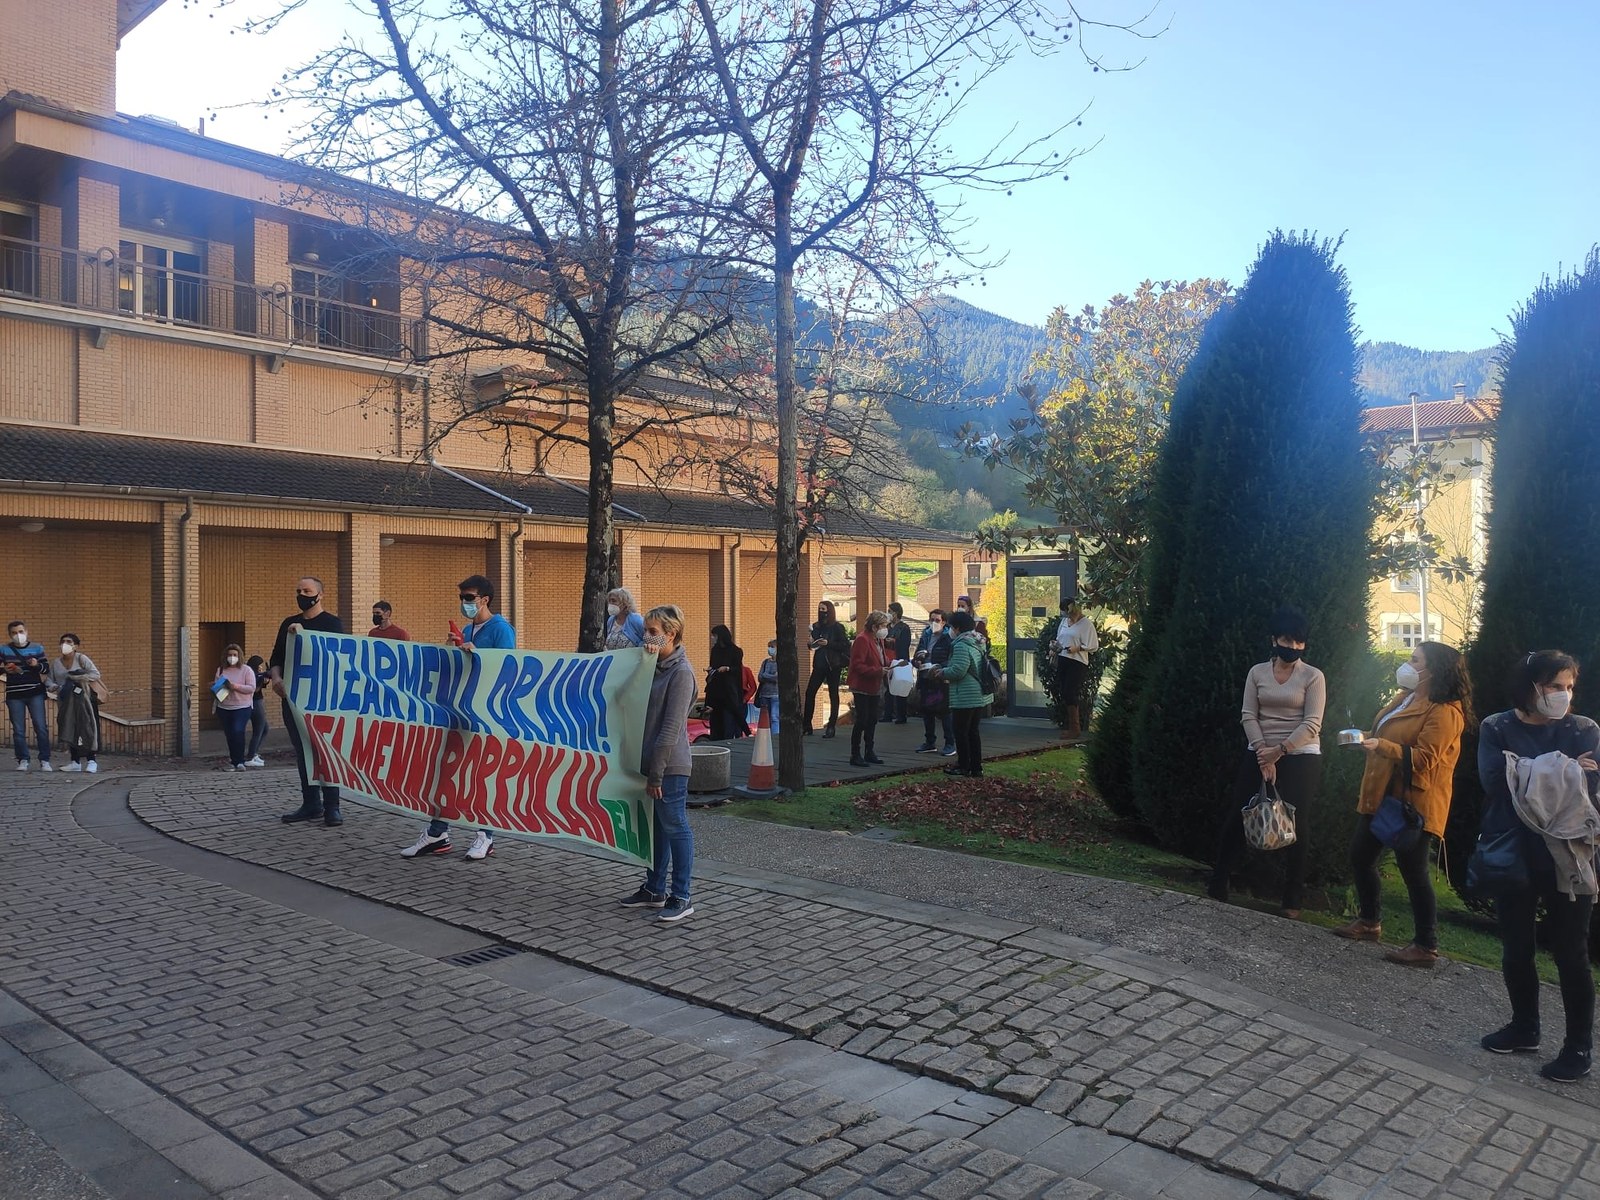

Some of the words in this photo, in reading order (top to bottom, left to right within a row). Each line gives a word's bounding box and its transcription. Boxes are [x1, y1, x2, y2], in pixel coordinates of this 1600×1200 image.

[290, 634, 492, 734] HITZARMENA
[486, 654, 614, 753] ORAIN!
[350, 716, 444, 818] MENNI
[434, 730, 616, 848] BORROKAN
[599, 798, 652, 864] ELA
